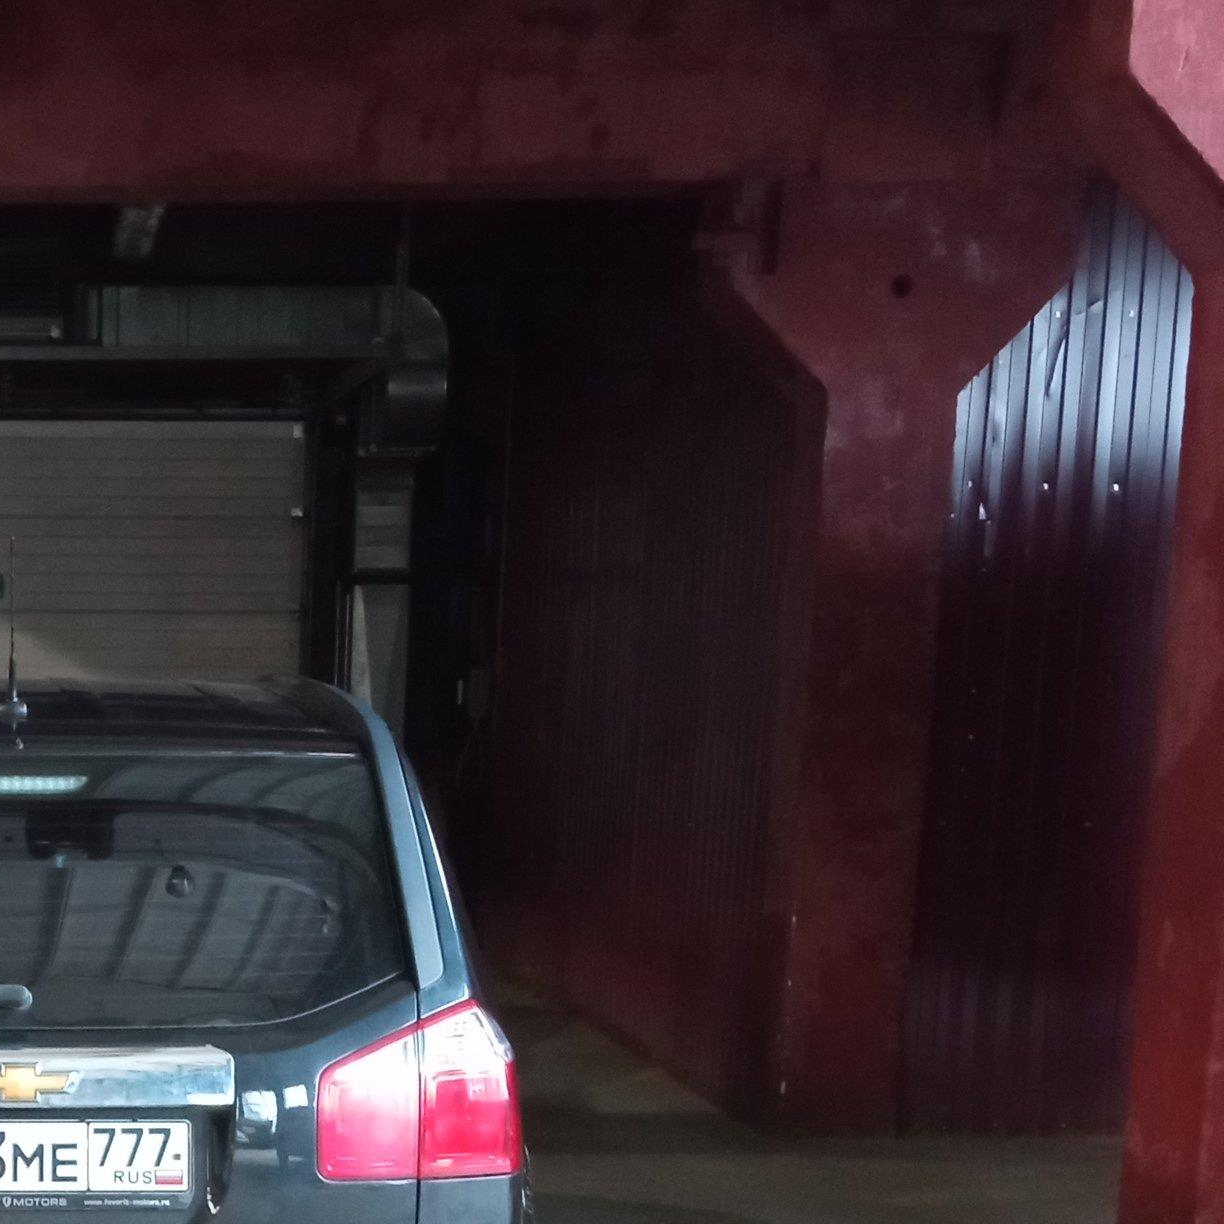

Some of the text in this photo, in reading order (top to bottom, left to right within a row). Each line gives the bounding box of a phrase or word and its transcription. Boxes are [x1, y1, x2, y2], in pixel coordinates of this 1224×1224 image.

[93, 1127, 172, 1168] 777
[114, 1170, 153, 1185] RUS
[13, 1197, 67, 1207] MOTORS
